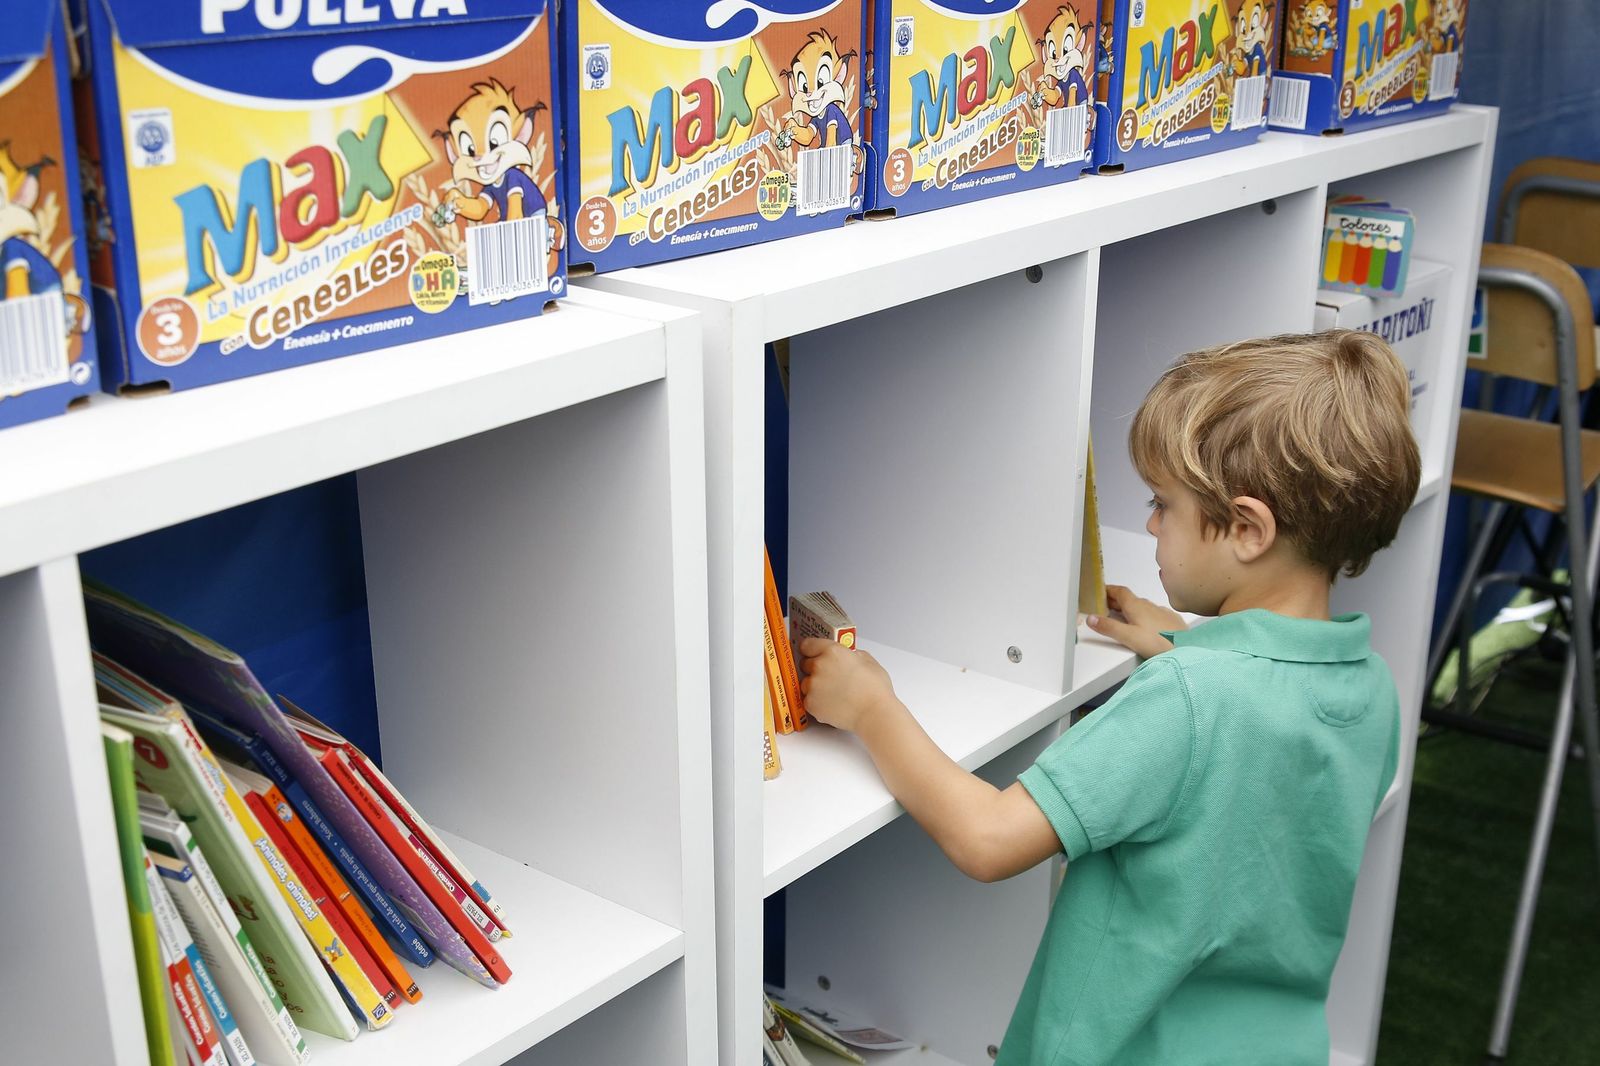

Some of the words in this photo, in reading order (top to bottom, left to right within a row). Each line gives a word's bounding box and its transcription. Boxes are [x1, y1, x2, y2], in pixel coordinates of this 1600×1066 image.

[1354, 0, 1417, 80] Max
[1135, 3, 1218, 110] Max
[590, 80, 605, 90] AEP
[908, 25, 1016, 149] Max
[1344, 89, 1352, 107] 3
[1154, 85, 1215, 145] Cereales
[607, 55, 752, 197] Max
[1123, 118, 1133, 139] 3
[935, 119, 1017, 189] Cereales
[1017, 140, 1040, 155] DHA
[893, 160, 905, 182] 3
[630, 232, 646, 245] con
[648, 160, 757, 241] Cereales
[759, 185, 788, 203] DHA
[174, 114, 394, 296] Max
[623, 201, 637, 218] La
[589, 210, 605, 235] 3
[1340, 216, 1391, 234] Colores
[587, 236, 607, 246] años
[671, 230, 702, 245] Energía
[412, 269, 455, 292] DHA
[222, 335, 245, 351] con
[249, 244, 407, 345] Cereales
[207, 299, 228, 320] La
[156, 312, 183, 346] 3
[284, 329, 331, 349] Energía
[342, 316, 414, 338] Crecimiento
[255, 838, 287, 882] ¡Animales,
[286, 881, 319, 920] animales!
[354, 868, 369, 885] todo
[365, 880, 378, 894] que
[373, 891, 389, 908] araña
[384, 905, 394, 916] de
[389, 912, 402, 925] tela
[397, 922, 407, 932] La
[410, 937, 429, 958] edebé
[174, 982, 193, 1018] Infantiles
[188, 1016, 203, 1046] Cuentos
